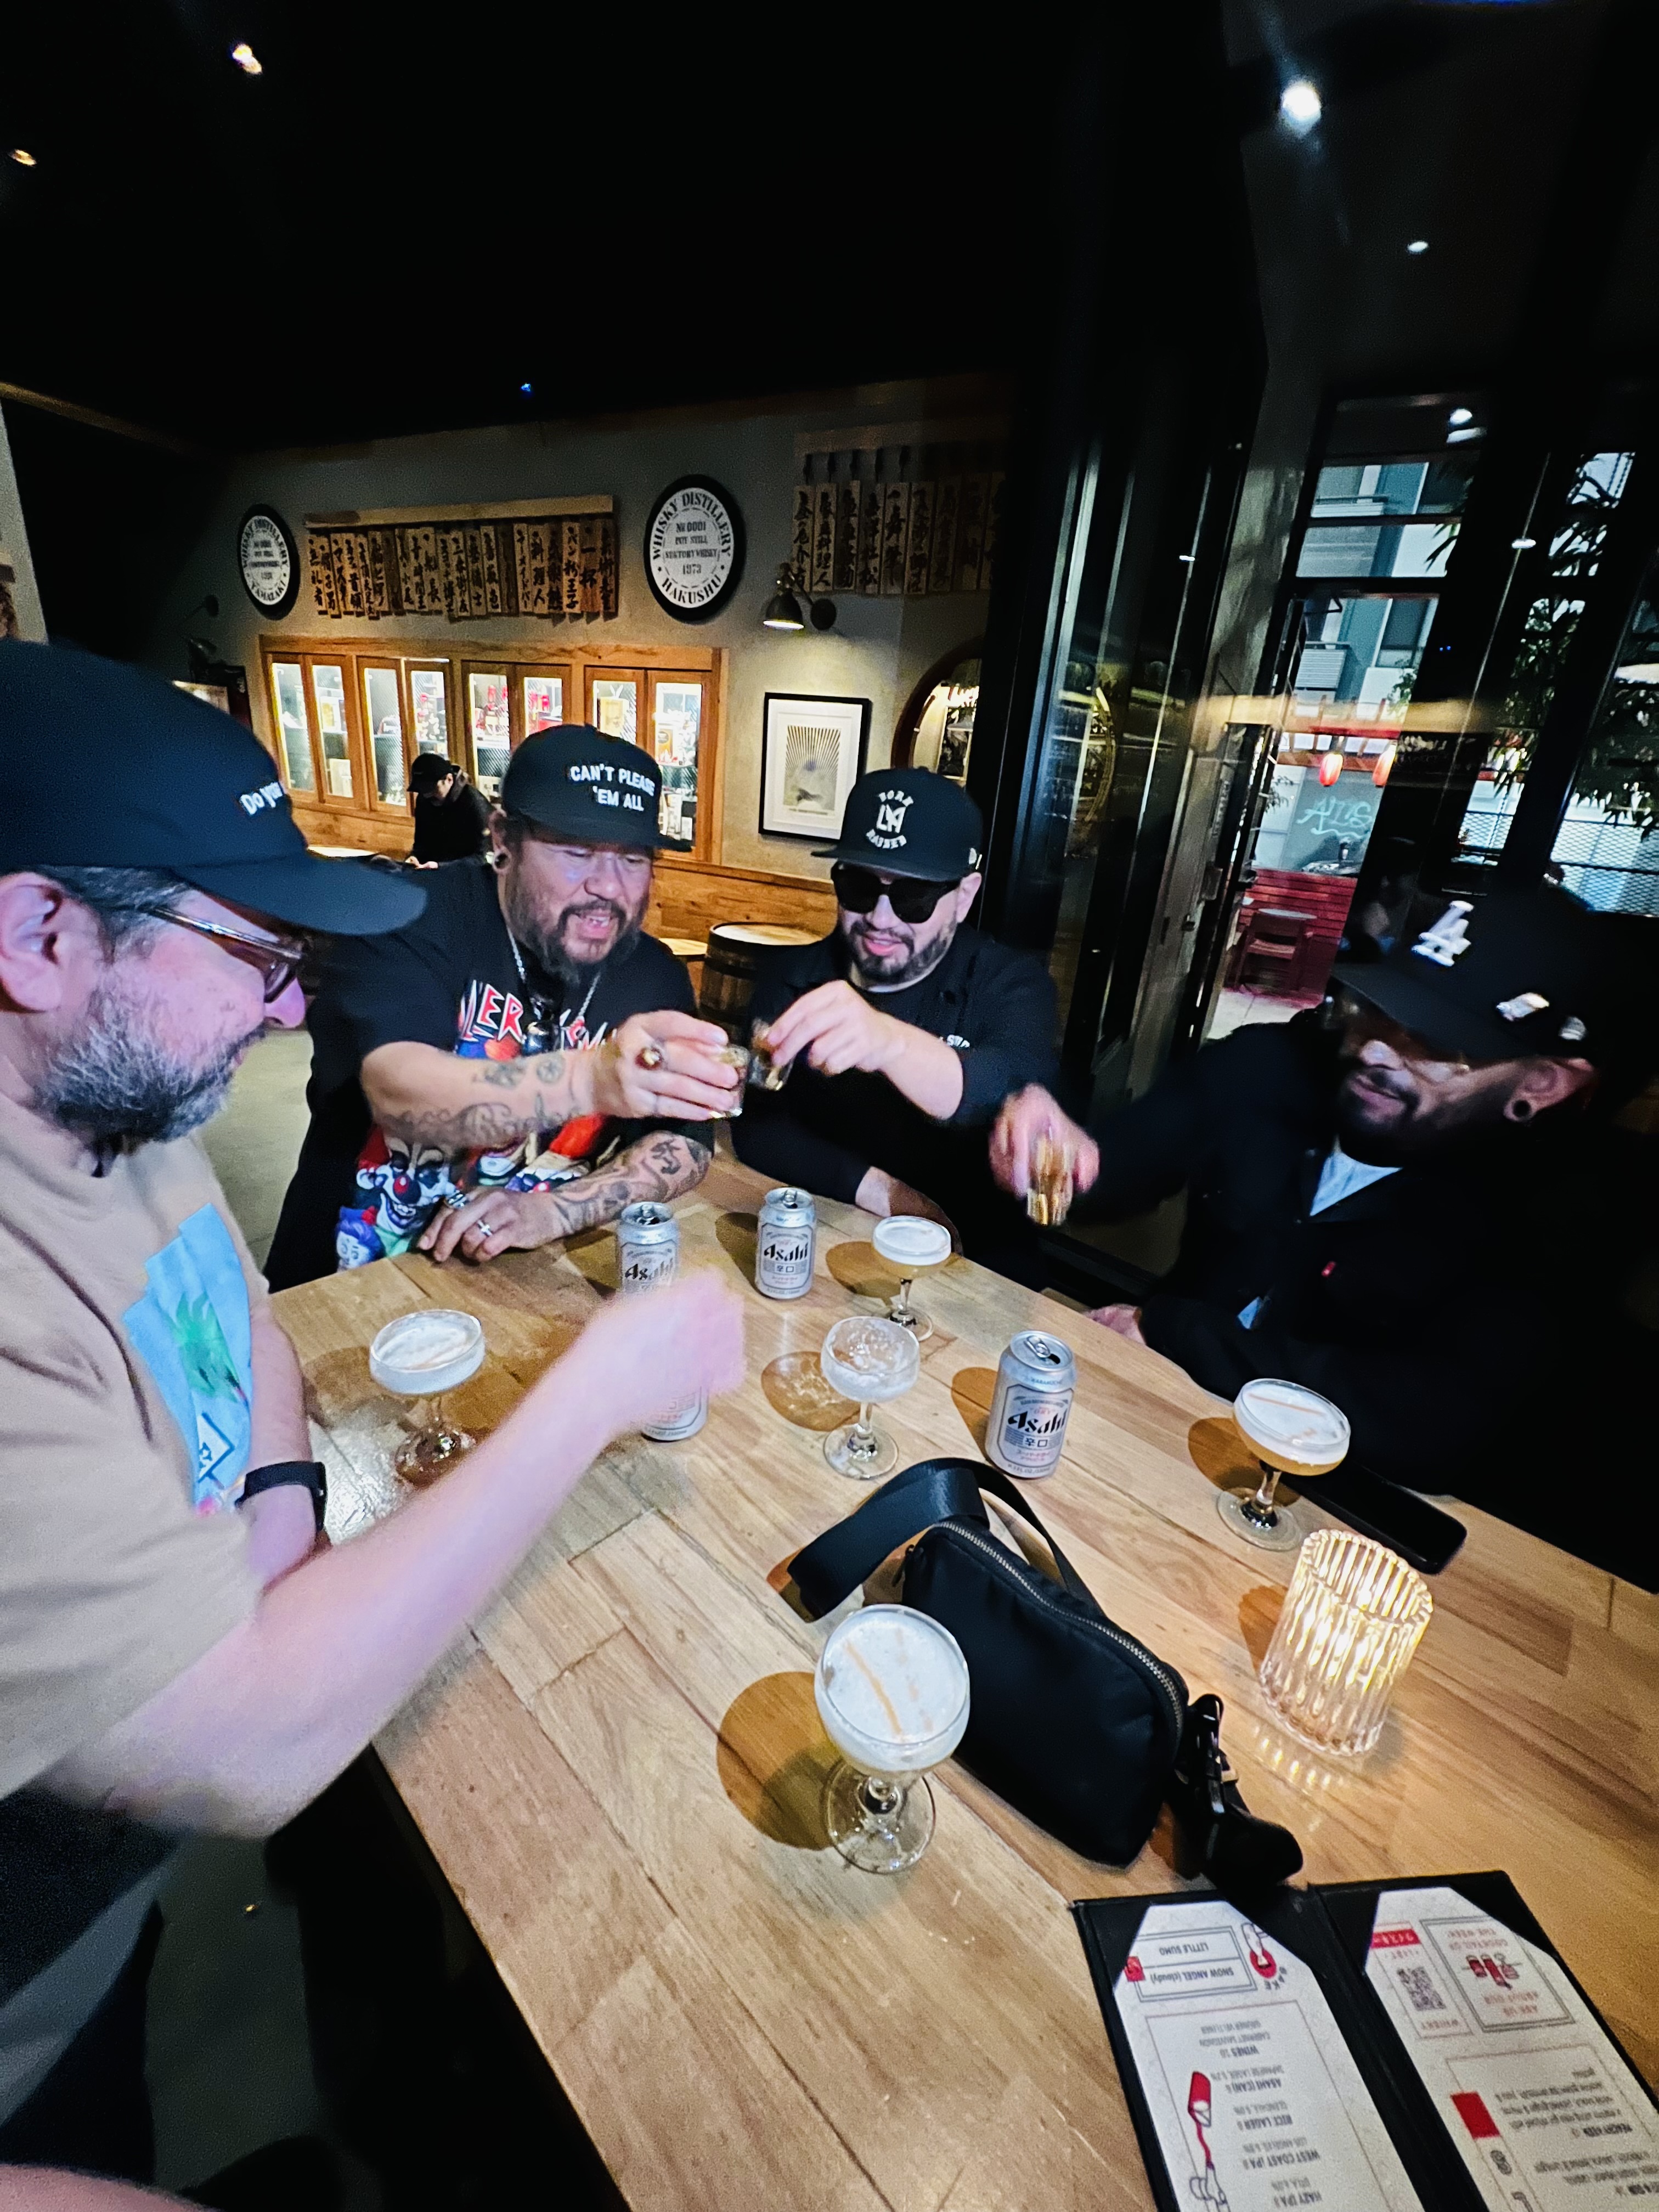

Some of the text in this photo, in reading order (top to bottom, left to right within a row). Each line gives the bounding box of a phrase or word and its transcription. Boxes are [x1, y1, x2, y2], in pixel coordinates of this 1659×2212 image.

[652, 492, 731, 560] WHISKY DISTILLERY
[662, 574, 721, 604] HAKUSHU
[570, 763, 656, 797] CAN'T PLEASE
[239, 792, 265, 815] Do
[592, 785, 645, 812] 'EM ALL
[764, 1242, 808, 1262] Asahi
[1008, 1408, 1068, 1434] Asahi
[1159, 1942, 1209, 1956] LITTLE SUMO
[1149, 1966, 1234, 1984] SNOW ANGEL (cloudy)
[1263, 1966, 1287, 1991] SAKE
[1231, 2045, 1260, 2058] WINES
[1255, 2078, 1282, 2091] ASAHI
[1244, 2117, 1272, 2130] LAGER
[1249, 2157, 1265, 2170] IPA
[1266, 2152, 1295, 2168] COAST
[1296, 2149, 1321, 2163] WEST
